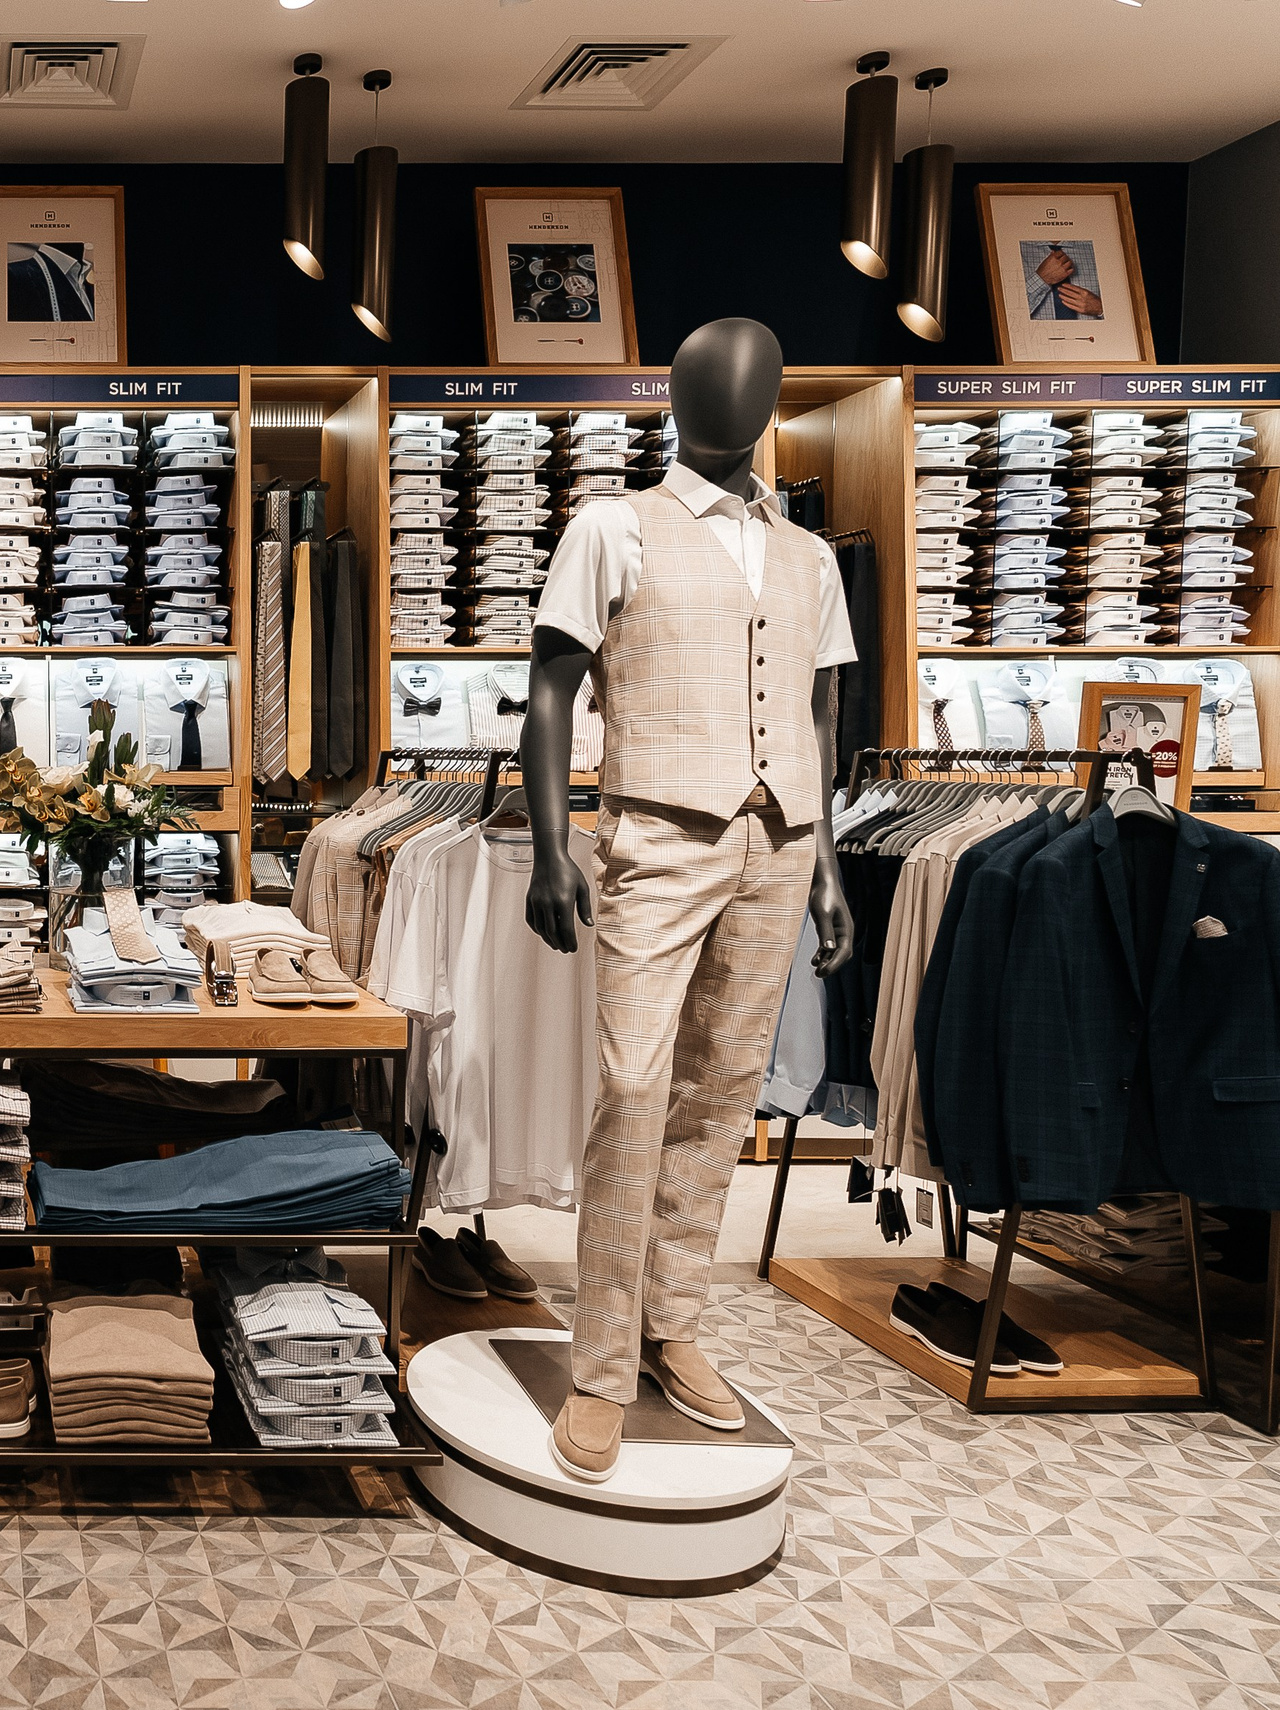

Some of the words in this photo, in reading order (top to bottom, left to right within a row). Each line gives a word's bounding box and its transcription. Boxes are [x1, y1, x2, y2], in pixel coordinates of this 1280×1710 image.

[109, 382, 147, 395] SLIM
[157, 382, 182, 395] FIT
[445, 383, 483, 395] SLIM
[493, 383, 518, 395] FIT
[631, 382, 670, 396] SLIM
[937, 381, 993, 394] SUPER
[1001, 381, 1041, 394] SLIM
[1050, 381, 1076, 394] FIT
[1126, 380, 1183, 394] SUPER
[1191, 380, 1231, 394] SLIM
[1240, 380, 1267, 394] FIT
